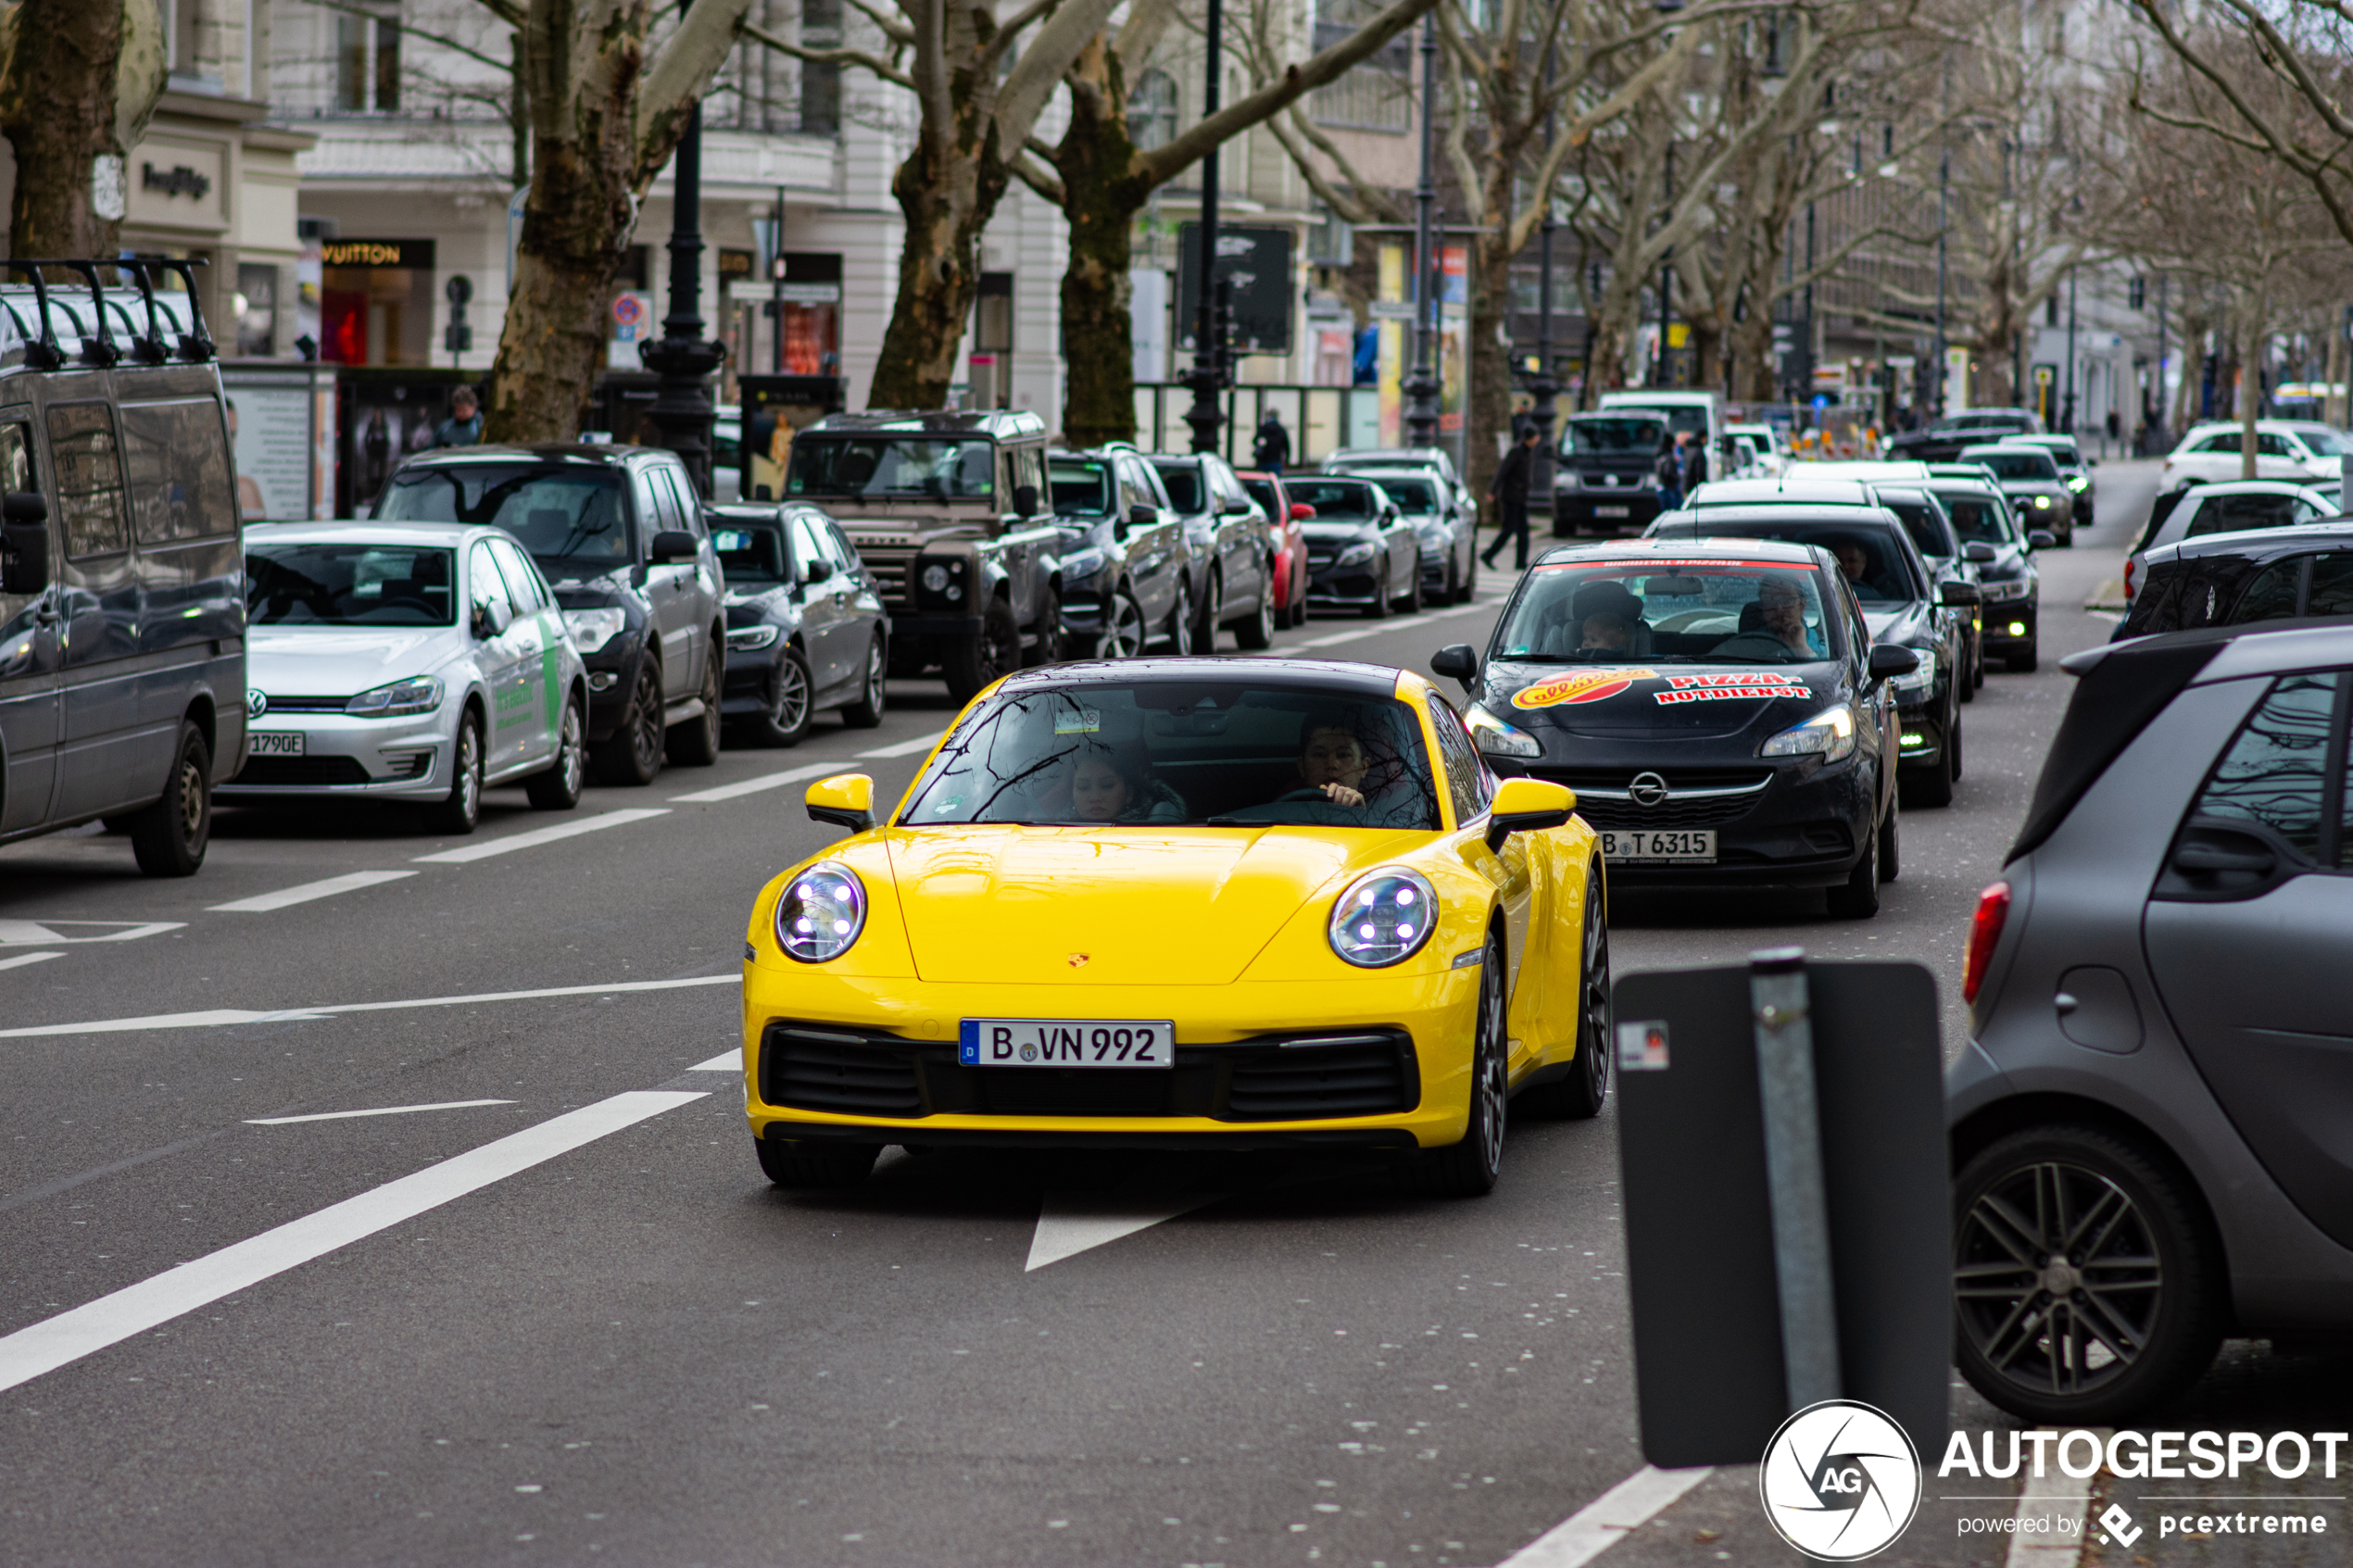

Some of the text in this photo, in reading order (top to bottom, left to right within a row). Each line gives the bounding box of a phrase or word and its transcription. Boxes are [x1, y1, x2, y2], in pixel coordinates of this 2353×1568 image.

[322, 244, 400, 265] VUITTON
[1654, 686, 1812, 706] NOTDIENST
[252, 734, 302, 753] 1790E
[1603, 834, 1706, 854] B T 6315
[992, 1027, 1155, 1061] B VN 992
